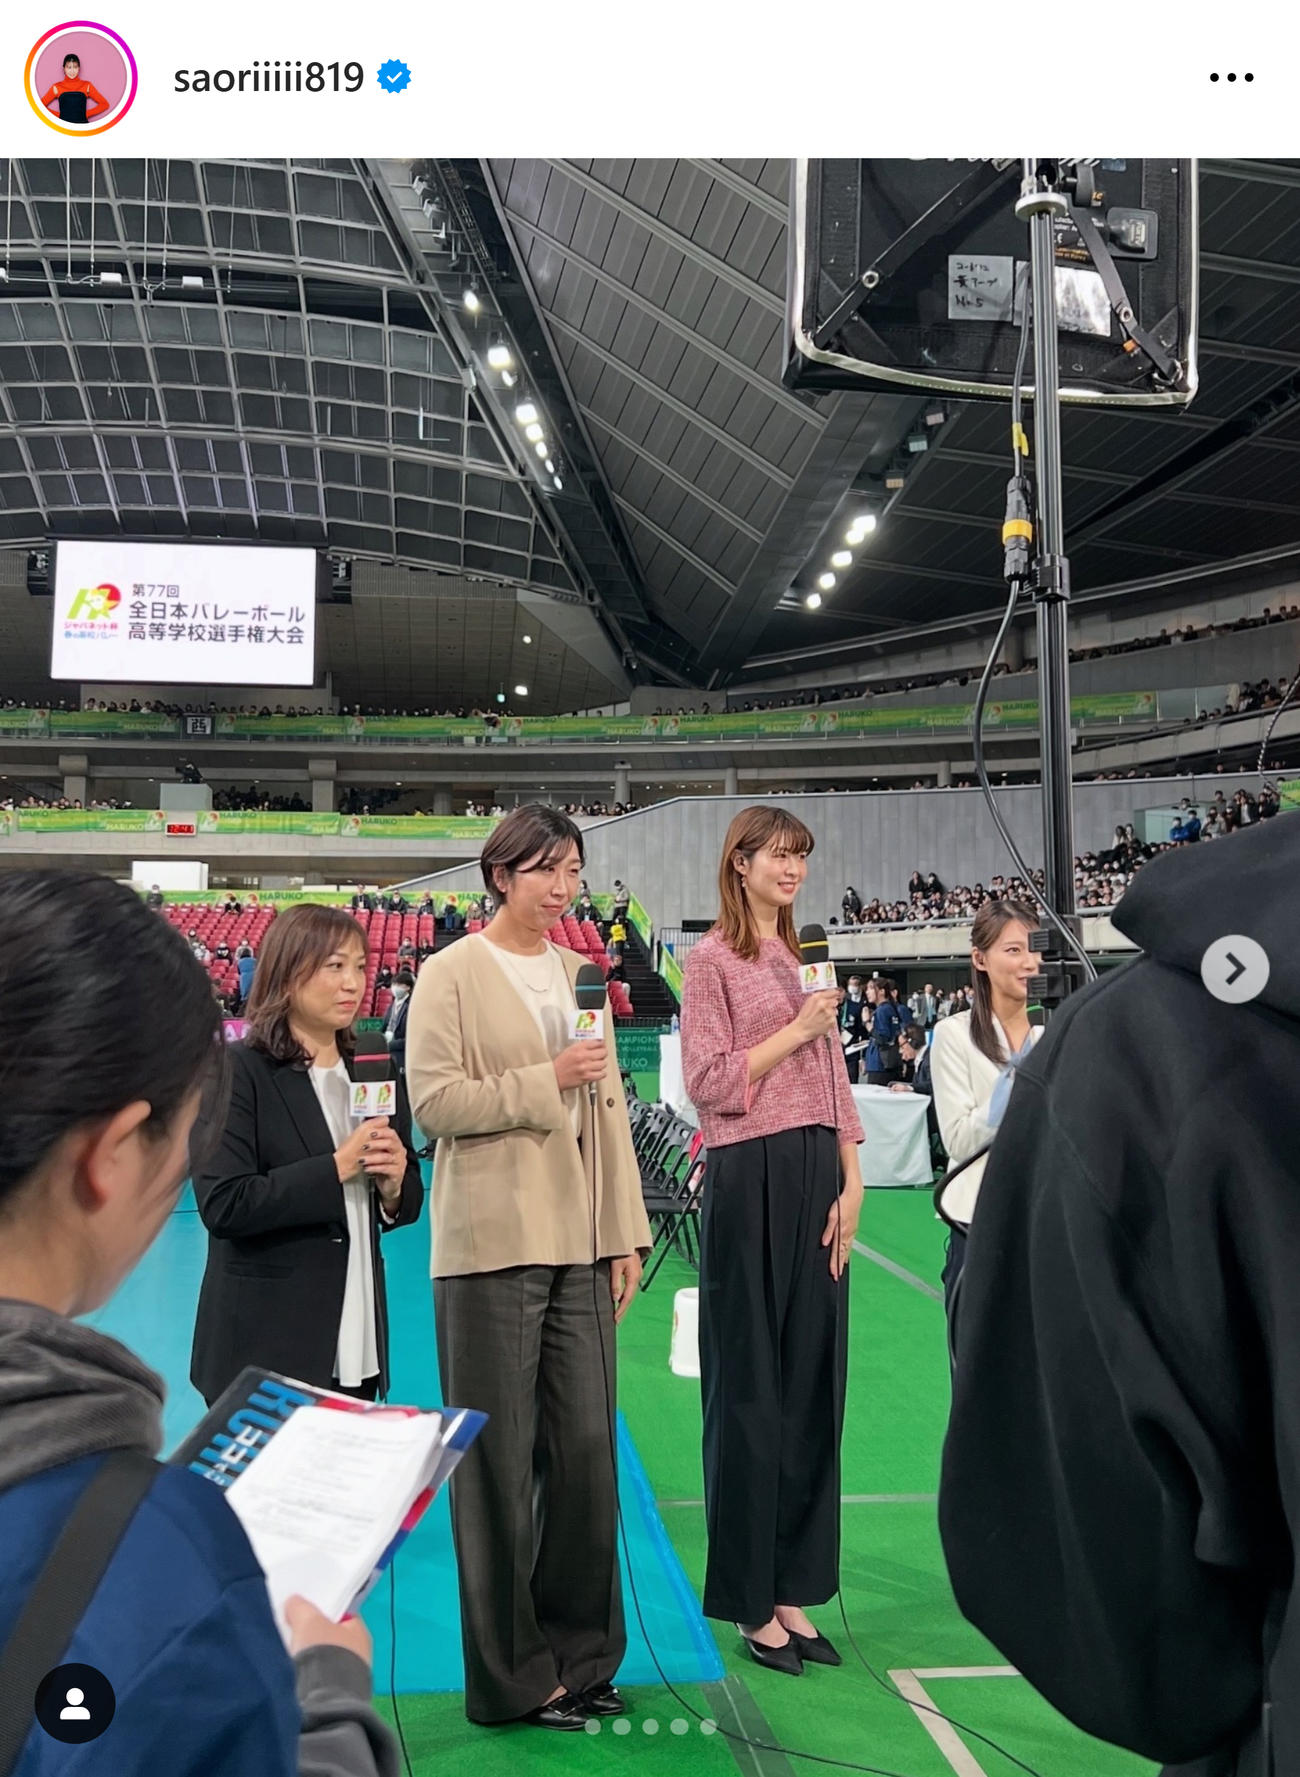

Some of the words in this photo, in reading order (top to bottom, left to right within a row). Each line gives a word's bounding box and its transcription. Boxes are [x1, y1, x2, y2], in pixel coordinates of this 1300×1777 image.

[132, 583, 180, 598] 第77回
[129, 600, 305, 623] 全日本バレーボール
[128, 621, 304, 644] 高等学校選手権大会
[260, 892, 304, 900] HARUKO
